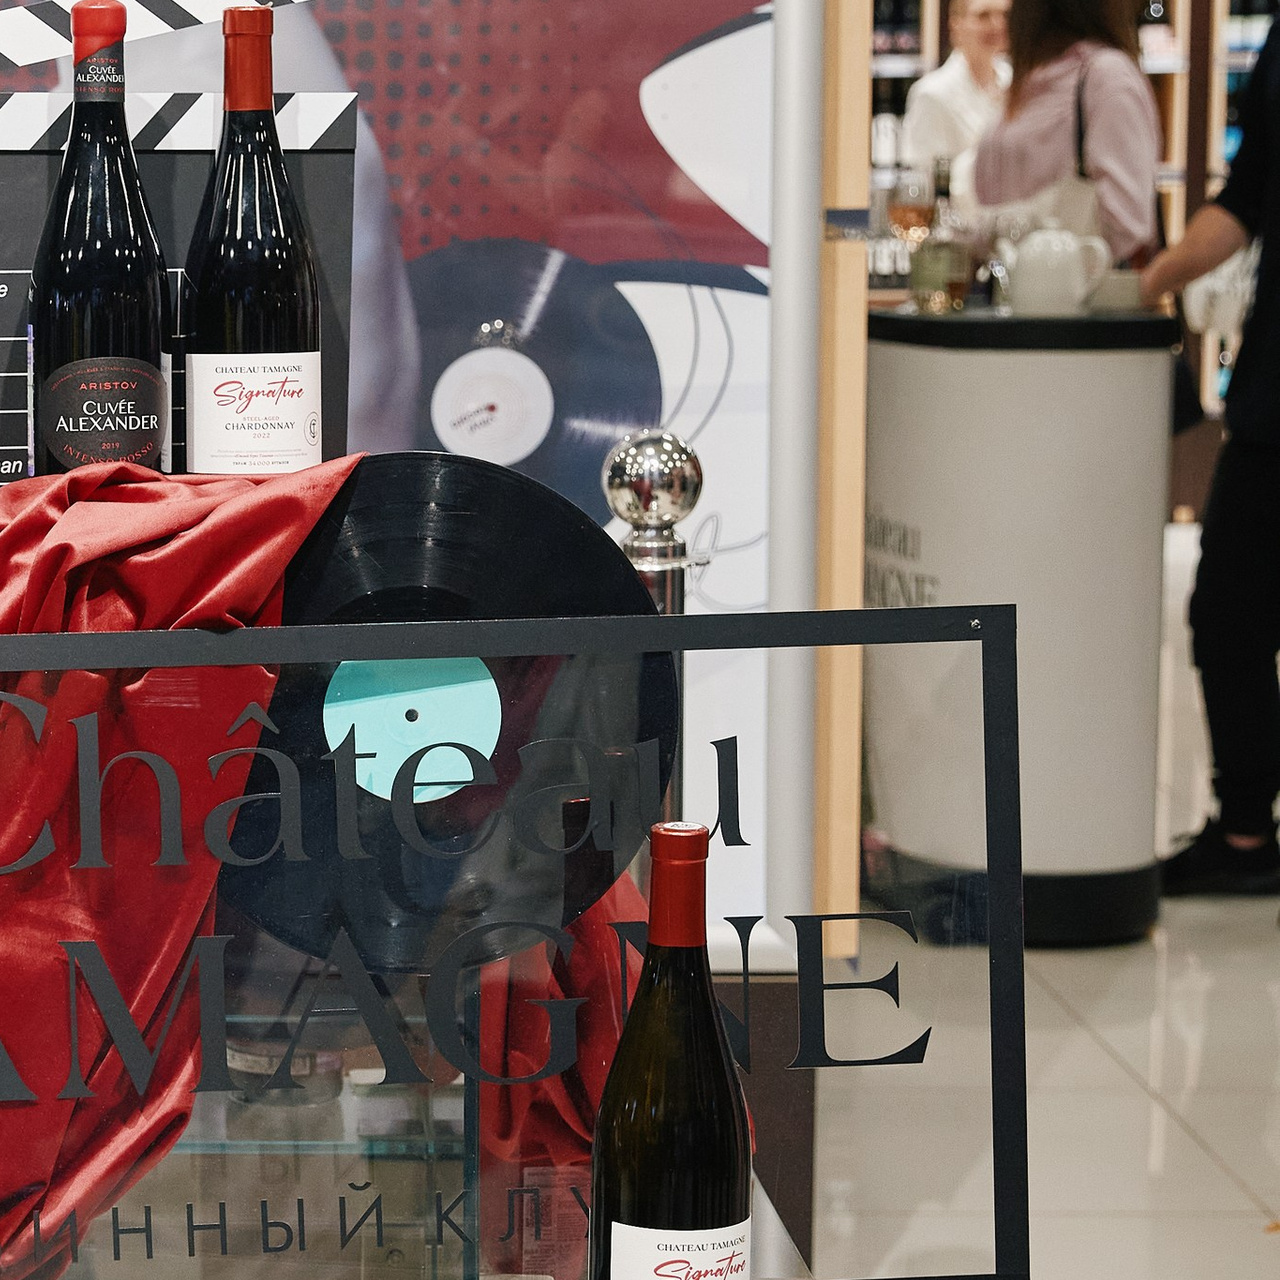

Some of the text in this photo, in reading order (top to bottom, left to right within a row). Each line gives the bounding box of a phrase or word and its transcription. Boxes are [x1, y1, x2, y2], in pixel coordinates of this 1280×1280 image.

[215, 365, 303, 374] CHATEAU TAMAGNE
[79, 381, 138, 391] ARISTOV
[213, 376, 304, 414] Signature
[82, 399, 136, 416] CUVÉE
[55, 414, 159, 432] ALEXANDER
[224, 421, 296, 430] CHARDONNAY
[101, 442, 120, 450] 2019
[656, 1234, 746, 1252] CHATEAU TAMAGNE
